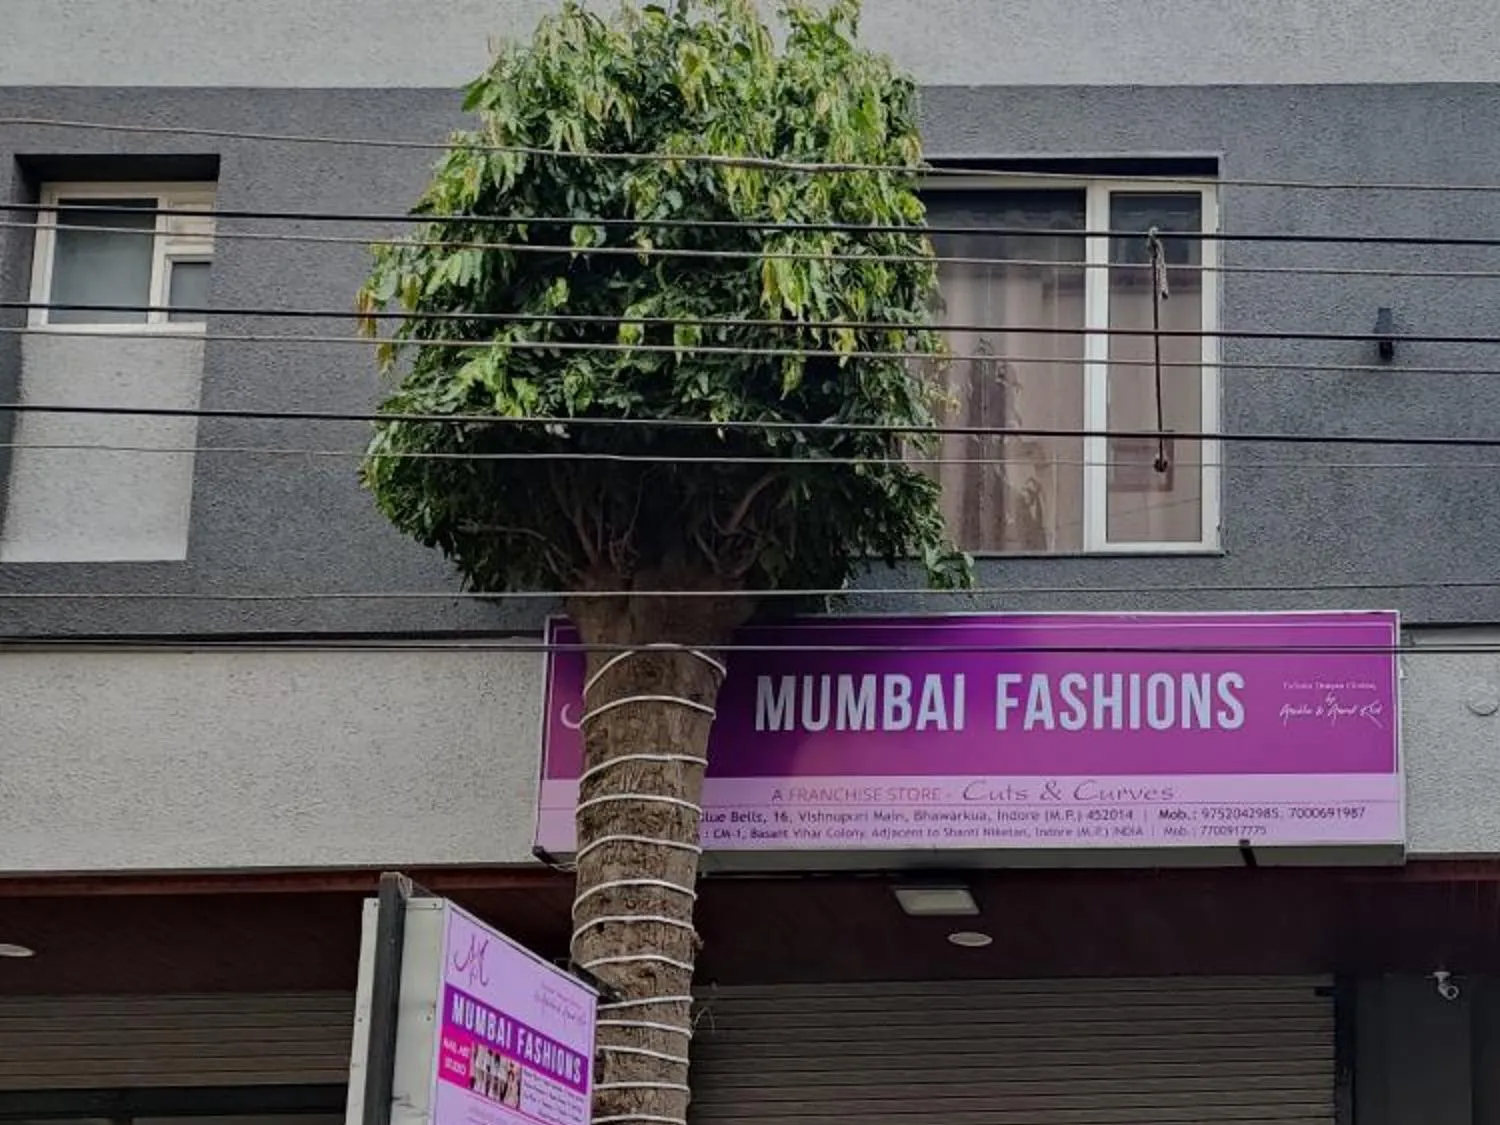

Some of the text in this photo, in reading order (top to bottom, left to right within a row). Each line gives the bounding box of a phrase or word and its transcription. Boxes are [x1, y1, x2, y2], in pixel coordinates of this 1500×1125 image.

[755, 674, 965, 732] MUMBAI
[996, 671, 1246, 730] FASHIONS
[771, 788, 783, 802] A
[788, 787, 883, 801] FRANCHISE
[888, 786, 941, 801] STORE
[962, 779, 1029, 801] Cuts
[1040, 779, 1063, 801] &
[1073, 779, 1175, 801] Curves
[700, 811, 727, 823] lue
[731, 811, 767, 824] Bells,
[799, 811, 868, 826] Vishnupuri
[997, 809, 1039, 822] Indore
[1087, 808, 1133, 822] 452014
[794, 828, 821, 840] Vihar
[871, 827, 923, 842] Adjacent
[927, 828, 940, 838] to
[943, 827, 979, 838] Shanti
[1035, 826, 1074, 838] Indore
[451, 992, 512, 1050] MUMBAI
[516, 1027, 582, 1085] FASHIONS
